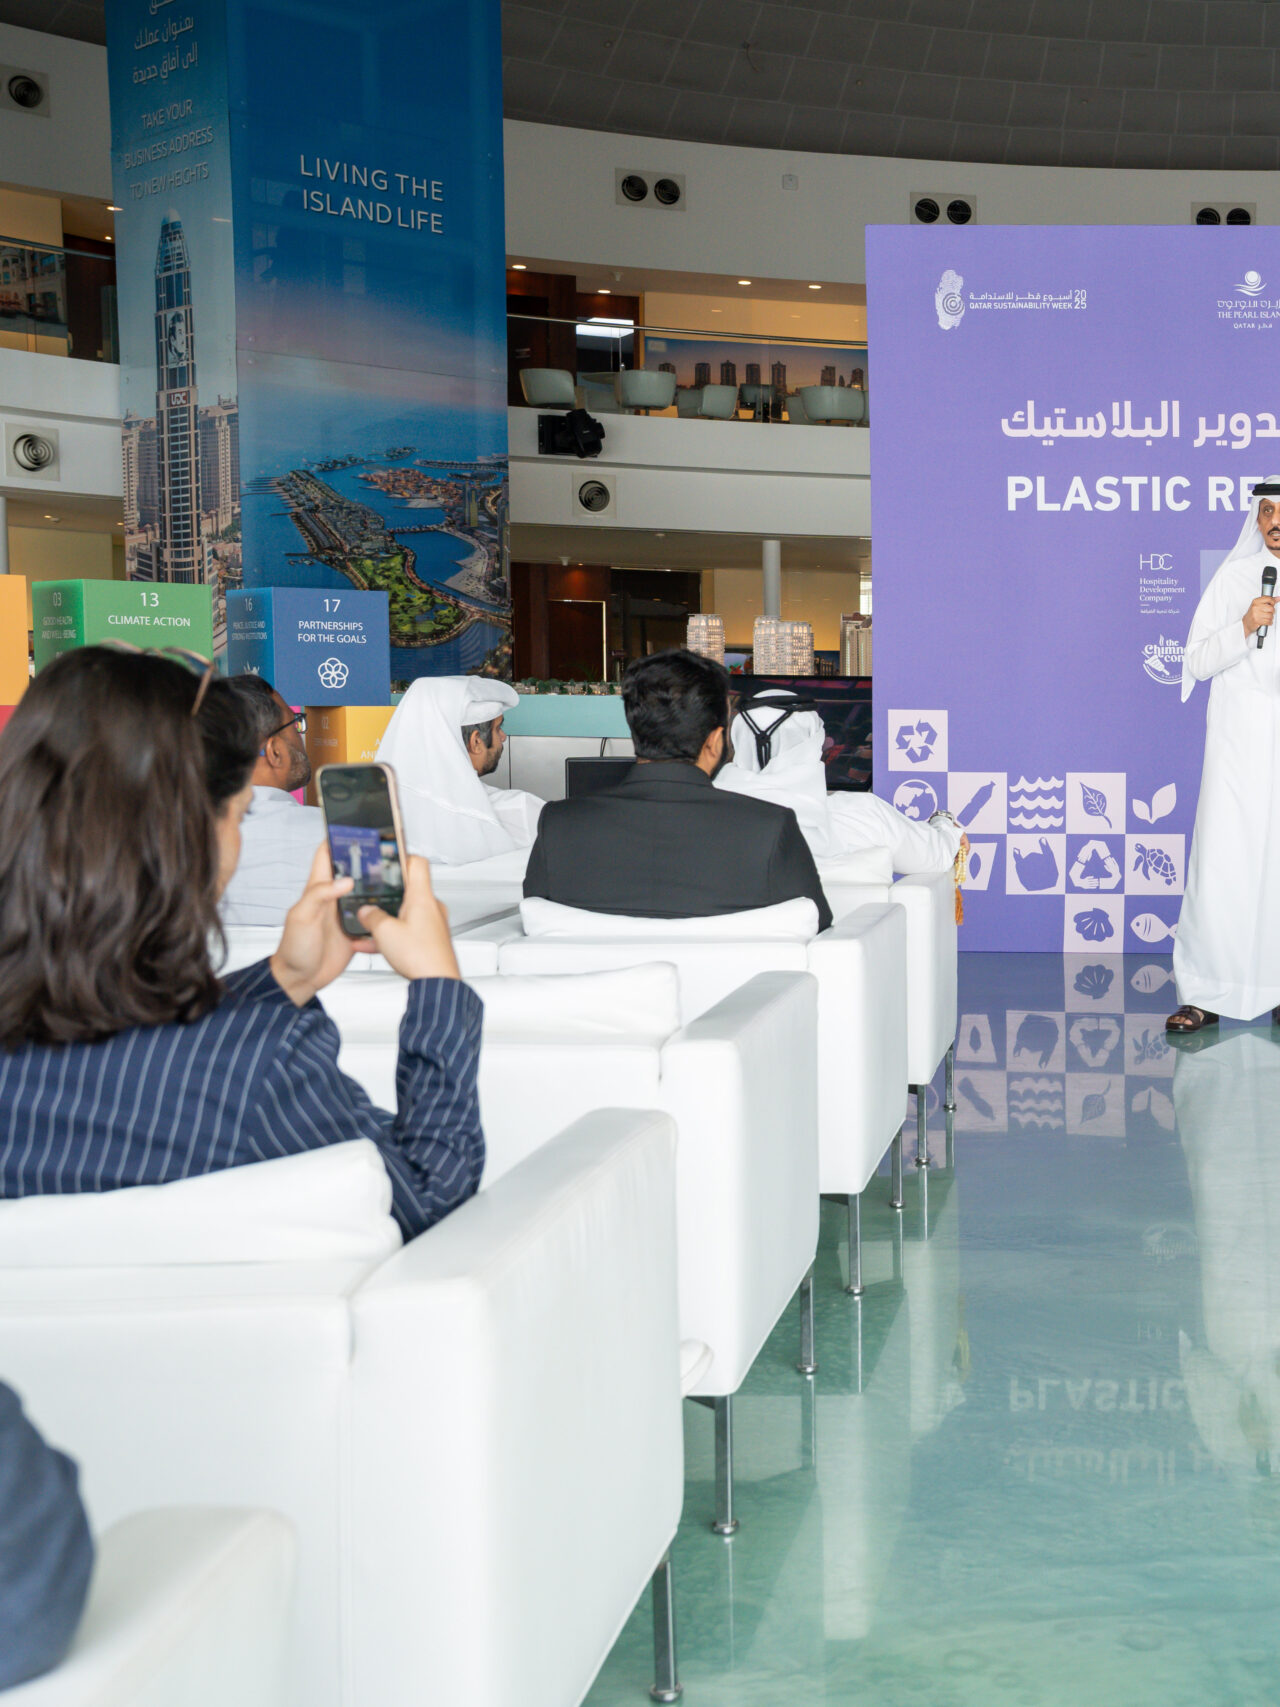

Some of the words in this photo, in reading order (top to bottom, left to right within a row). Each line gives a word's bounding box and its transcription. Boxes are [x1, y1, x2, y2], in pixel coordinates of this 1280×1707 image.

[162, 16, 194, 42] بعنوان
[134, 27, 160, 50] عملك
[133, 65, 159, 85] جديدة
[141, 109, 166, 129] TAKE
[166, 99, 193, 121] YOUR
[124, 141, 168, 169] BUSINESS
[169, 126, 215, 154] ADDRESS
[130, 182, 145, 200] TO
[144, 176, 168, 197] NEW
[168, 161, 209, 191] HEIGHTS
[300, 154, 389, 192] LIVING
[395, 173, 444, 202] THE
[303, 189, 393, 225] ISLAND
[397, 206, 444, 235] LIFE
[1016, 292, 1041, 301] قطر
[1042, 290, 1072, 301] أسبوع
[1074, 289, 1087, 300] 20
[1074, 300, 1087, 309] 25
[1001, 400, 1180, 446] البلاستيك
[1007, 476, 1191, 511] PLASTIC
[1139, 553, 1173, 571] HDC
[1139, 577, 1178, 587] Hospitality
[1139, 586, 1185, 595] Development
[53, 592, 62, 607] 03
[140, 592, 159, 607] 13
[245, 598, 253, 611] 16
[323, 599, 341, 612] 17
[1139, 594, 1172, 603] Company
[108, 615, 151, 626] CLIMATE
[153, 617, 191, 627] ACTION
[298, 621, 364, 631] PARTNERSHIPS
[297, 633, 317, 643] FOR
[318, 634, 335, 643] THE
[336, 635, 367, 644] GOALS
[1164, 654, 1183, 662] con
